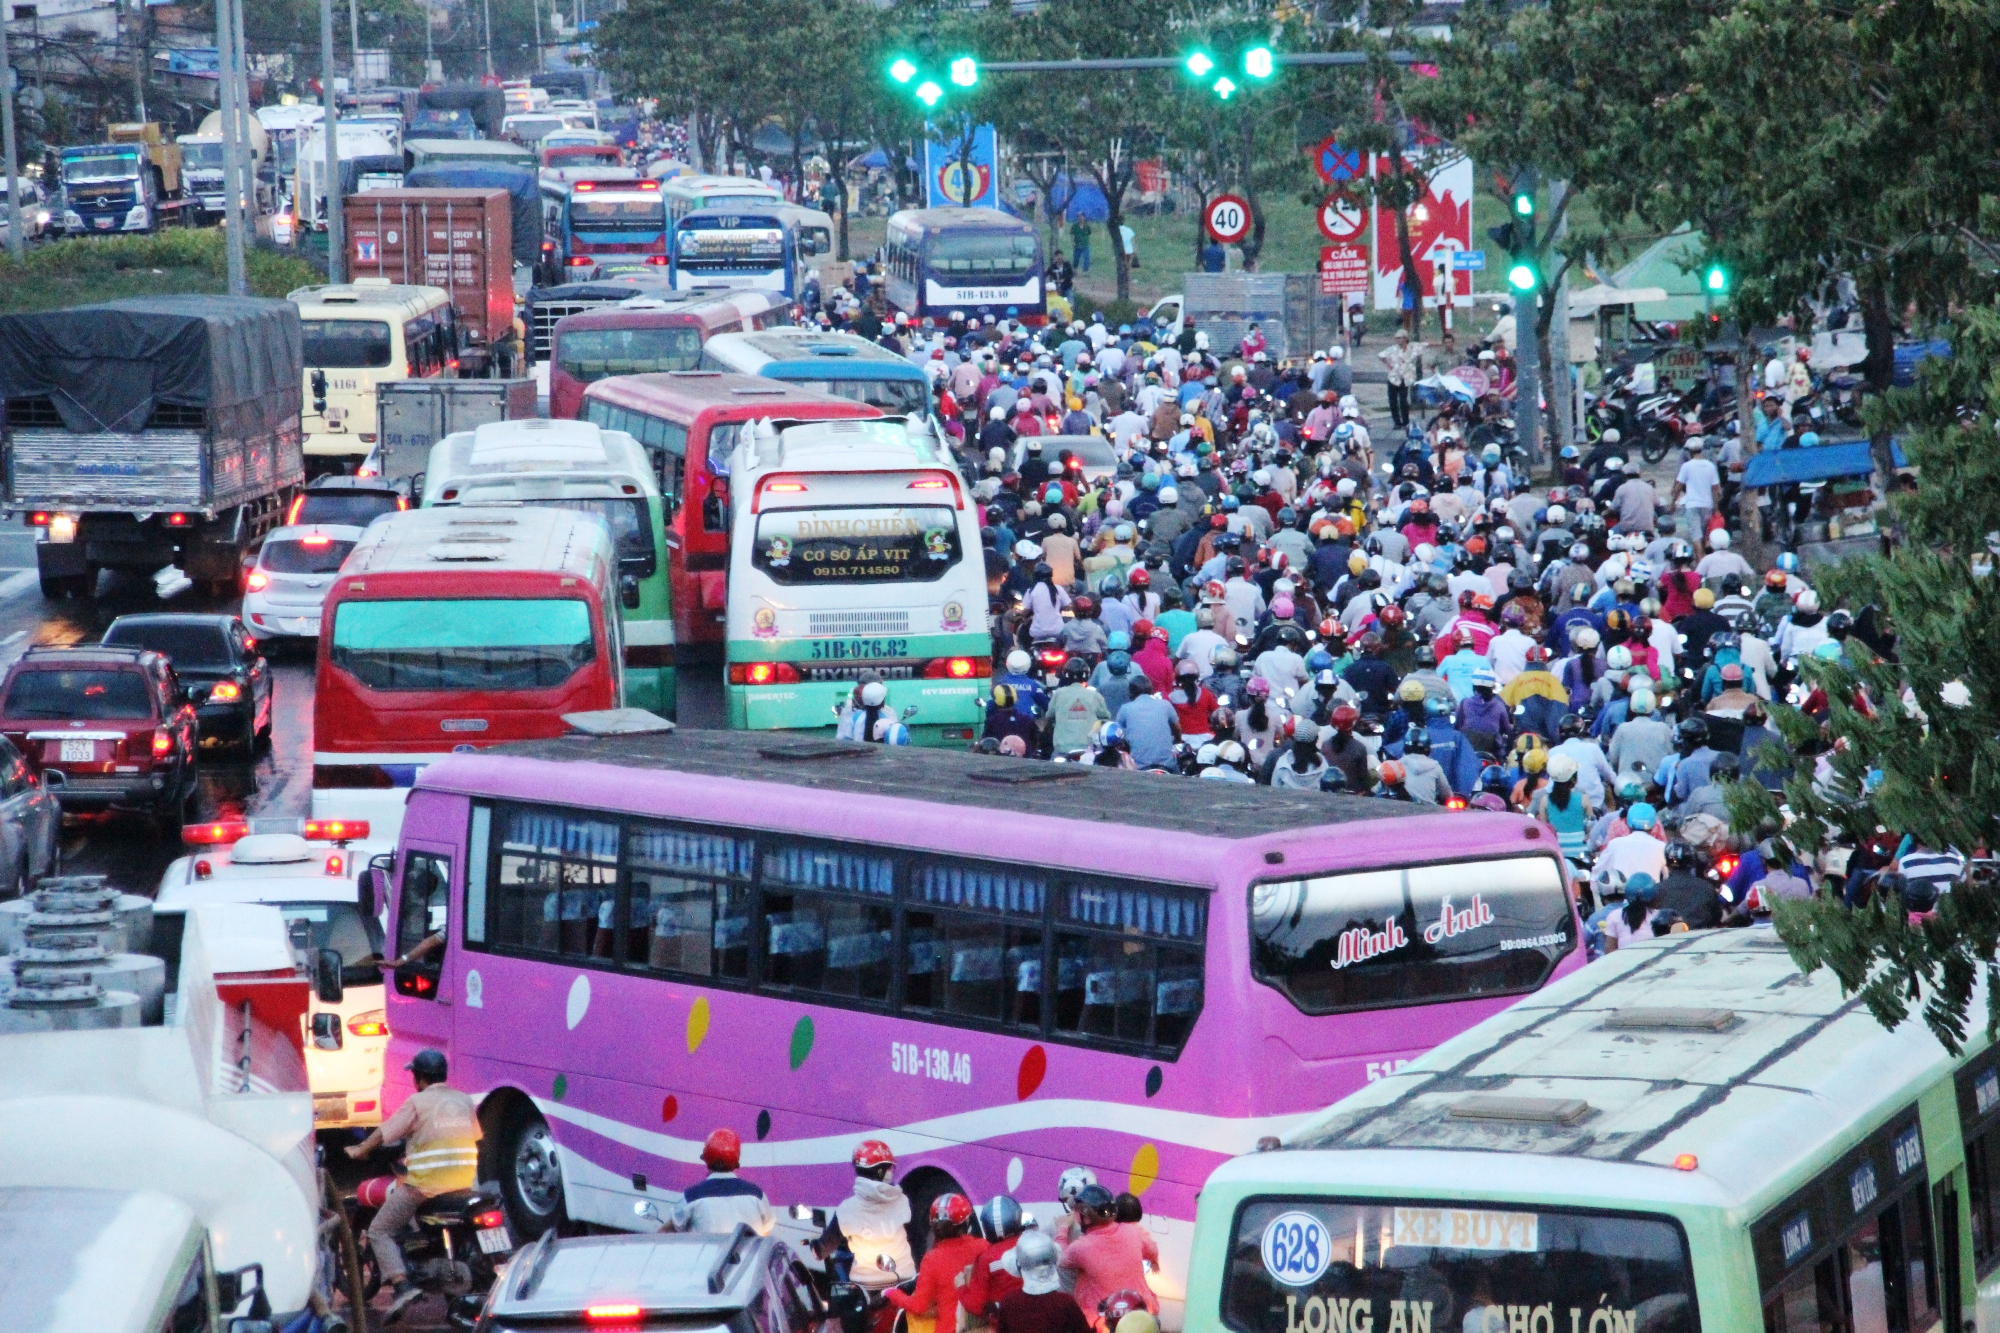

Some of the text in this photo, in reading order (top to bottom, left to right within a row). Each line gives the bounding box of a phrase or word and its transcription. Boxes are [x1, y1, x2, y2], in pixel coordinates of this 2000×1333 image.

[718, 217, 740, 227] VIP
[1215, 208, 1238, 228] 40
[1331, 246, 1357, 259] CẤM
[813, 566, 899, 576] 0913.714580
[811, 640, 908, 658] 51B-076.82
[68, 741, 87, 750] 52Y
[65, 751, 91, 760] 1033
[1331, 915, 1409, 969] Minh
[891, 1041, 972, 1085] 51B-138.46
[1397, 1211, 1442, 1244] XE
[1272, 1222, 1320, 1274] 628
[1286, 1296, 1373, 1333] LONG
[1389, 1300, 1433, 1333] AN
